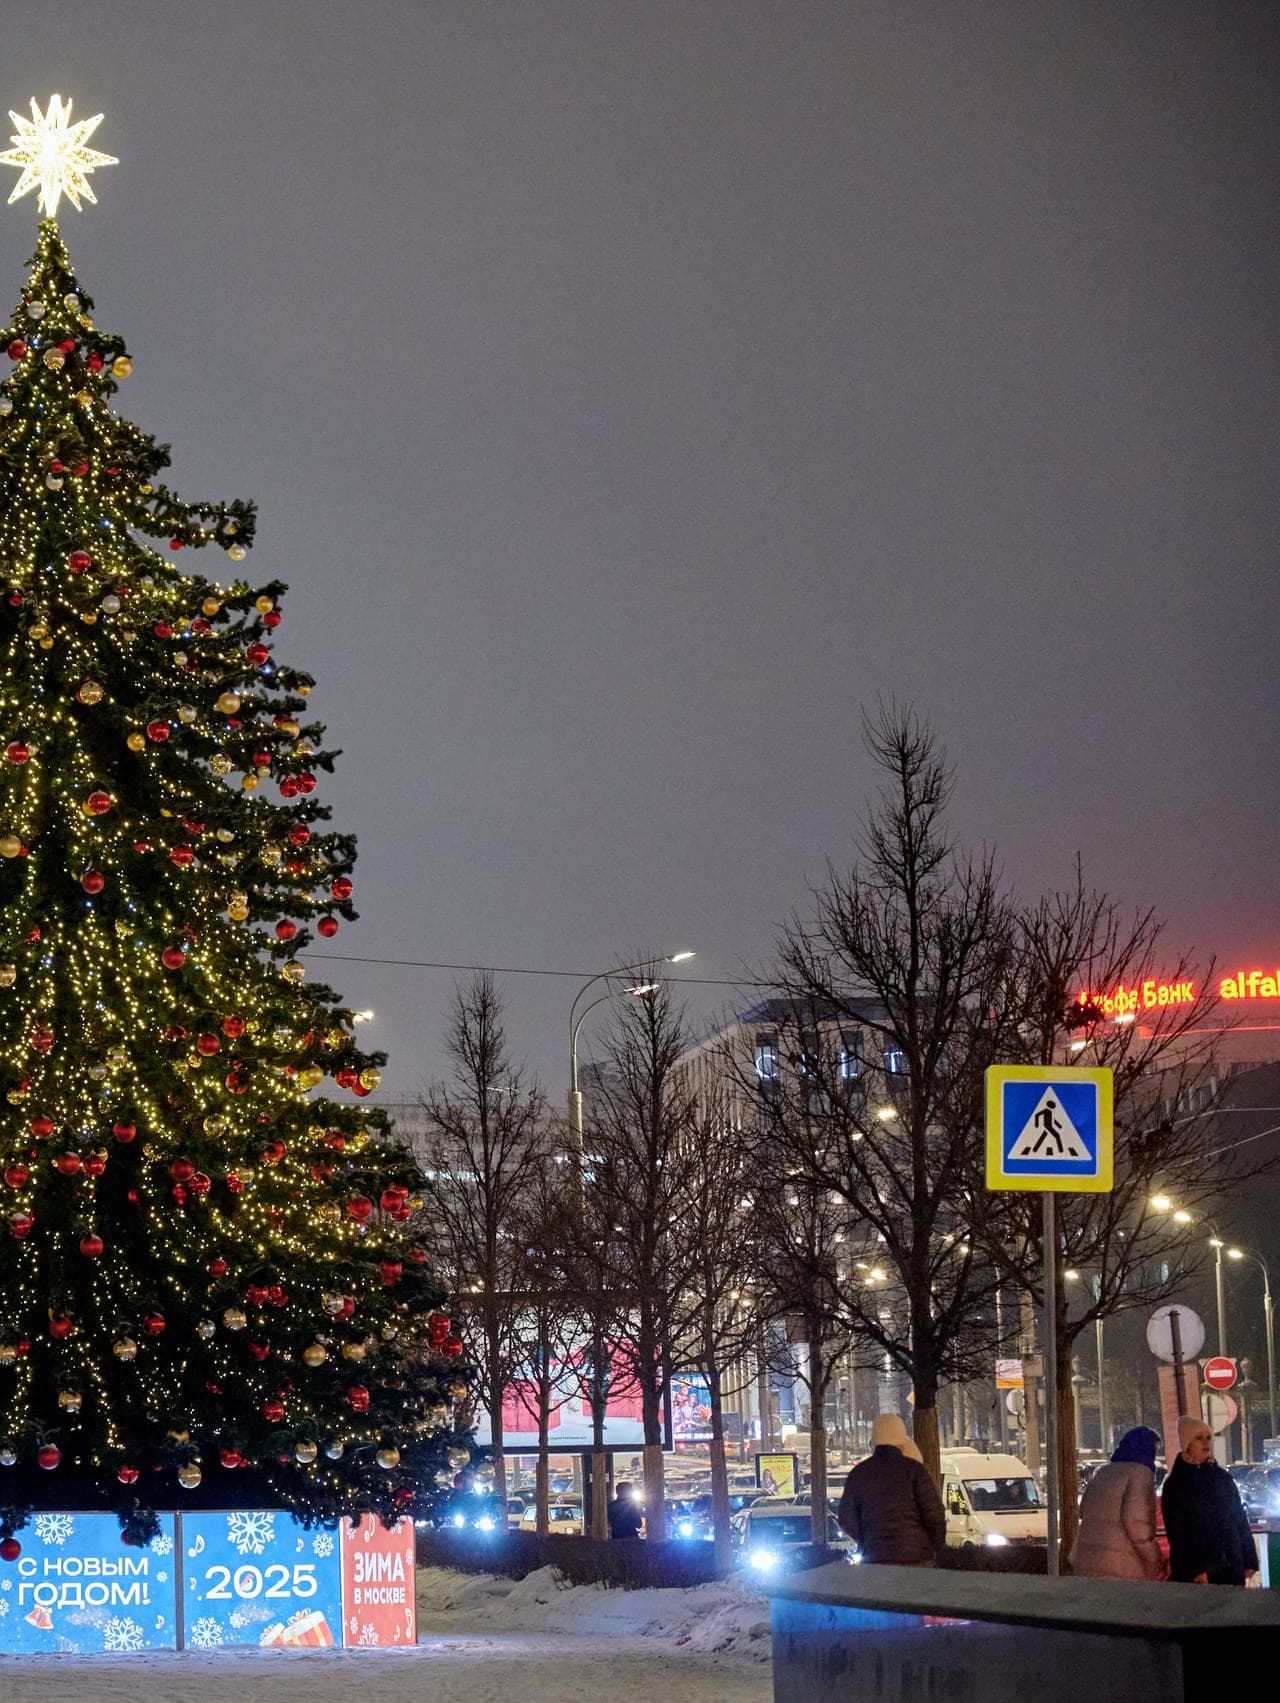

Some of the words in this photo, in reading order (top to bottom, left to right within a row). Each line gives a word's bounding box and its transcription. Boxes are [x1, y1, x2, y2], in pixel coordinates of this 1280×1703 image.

[1143, 981, 1194, 1008] Банк
[17, 1557, 37, 1576] С
[43, 1556, 149, 1576] НОВЫМ
[353, 1552, 406, 1583] ЗИМА
[205, 1564, 319, 1599] 2025
[18, 1582, 151, 1610] ГОДОМ!
[353, 1587, 361, 1604] В
[363, 1586, 406, 1605] МОСКВЕ
